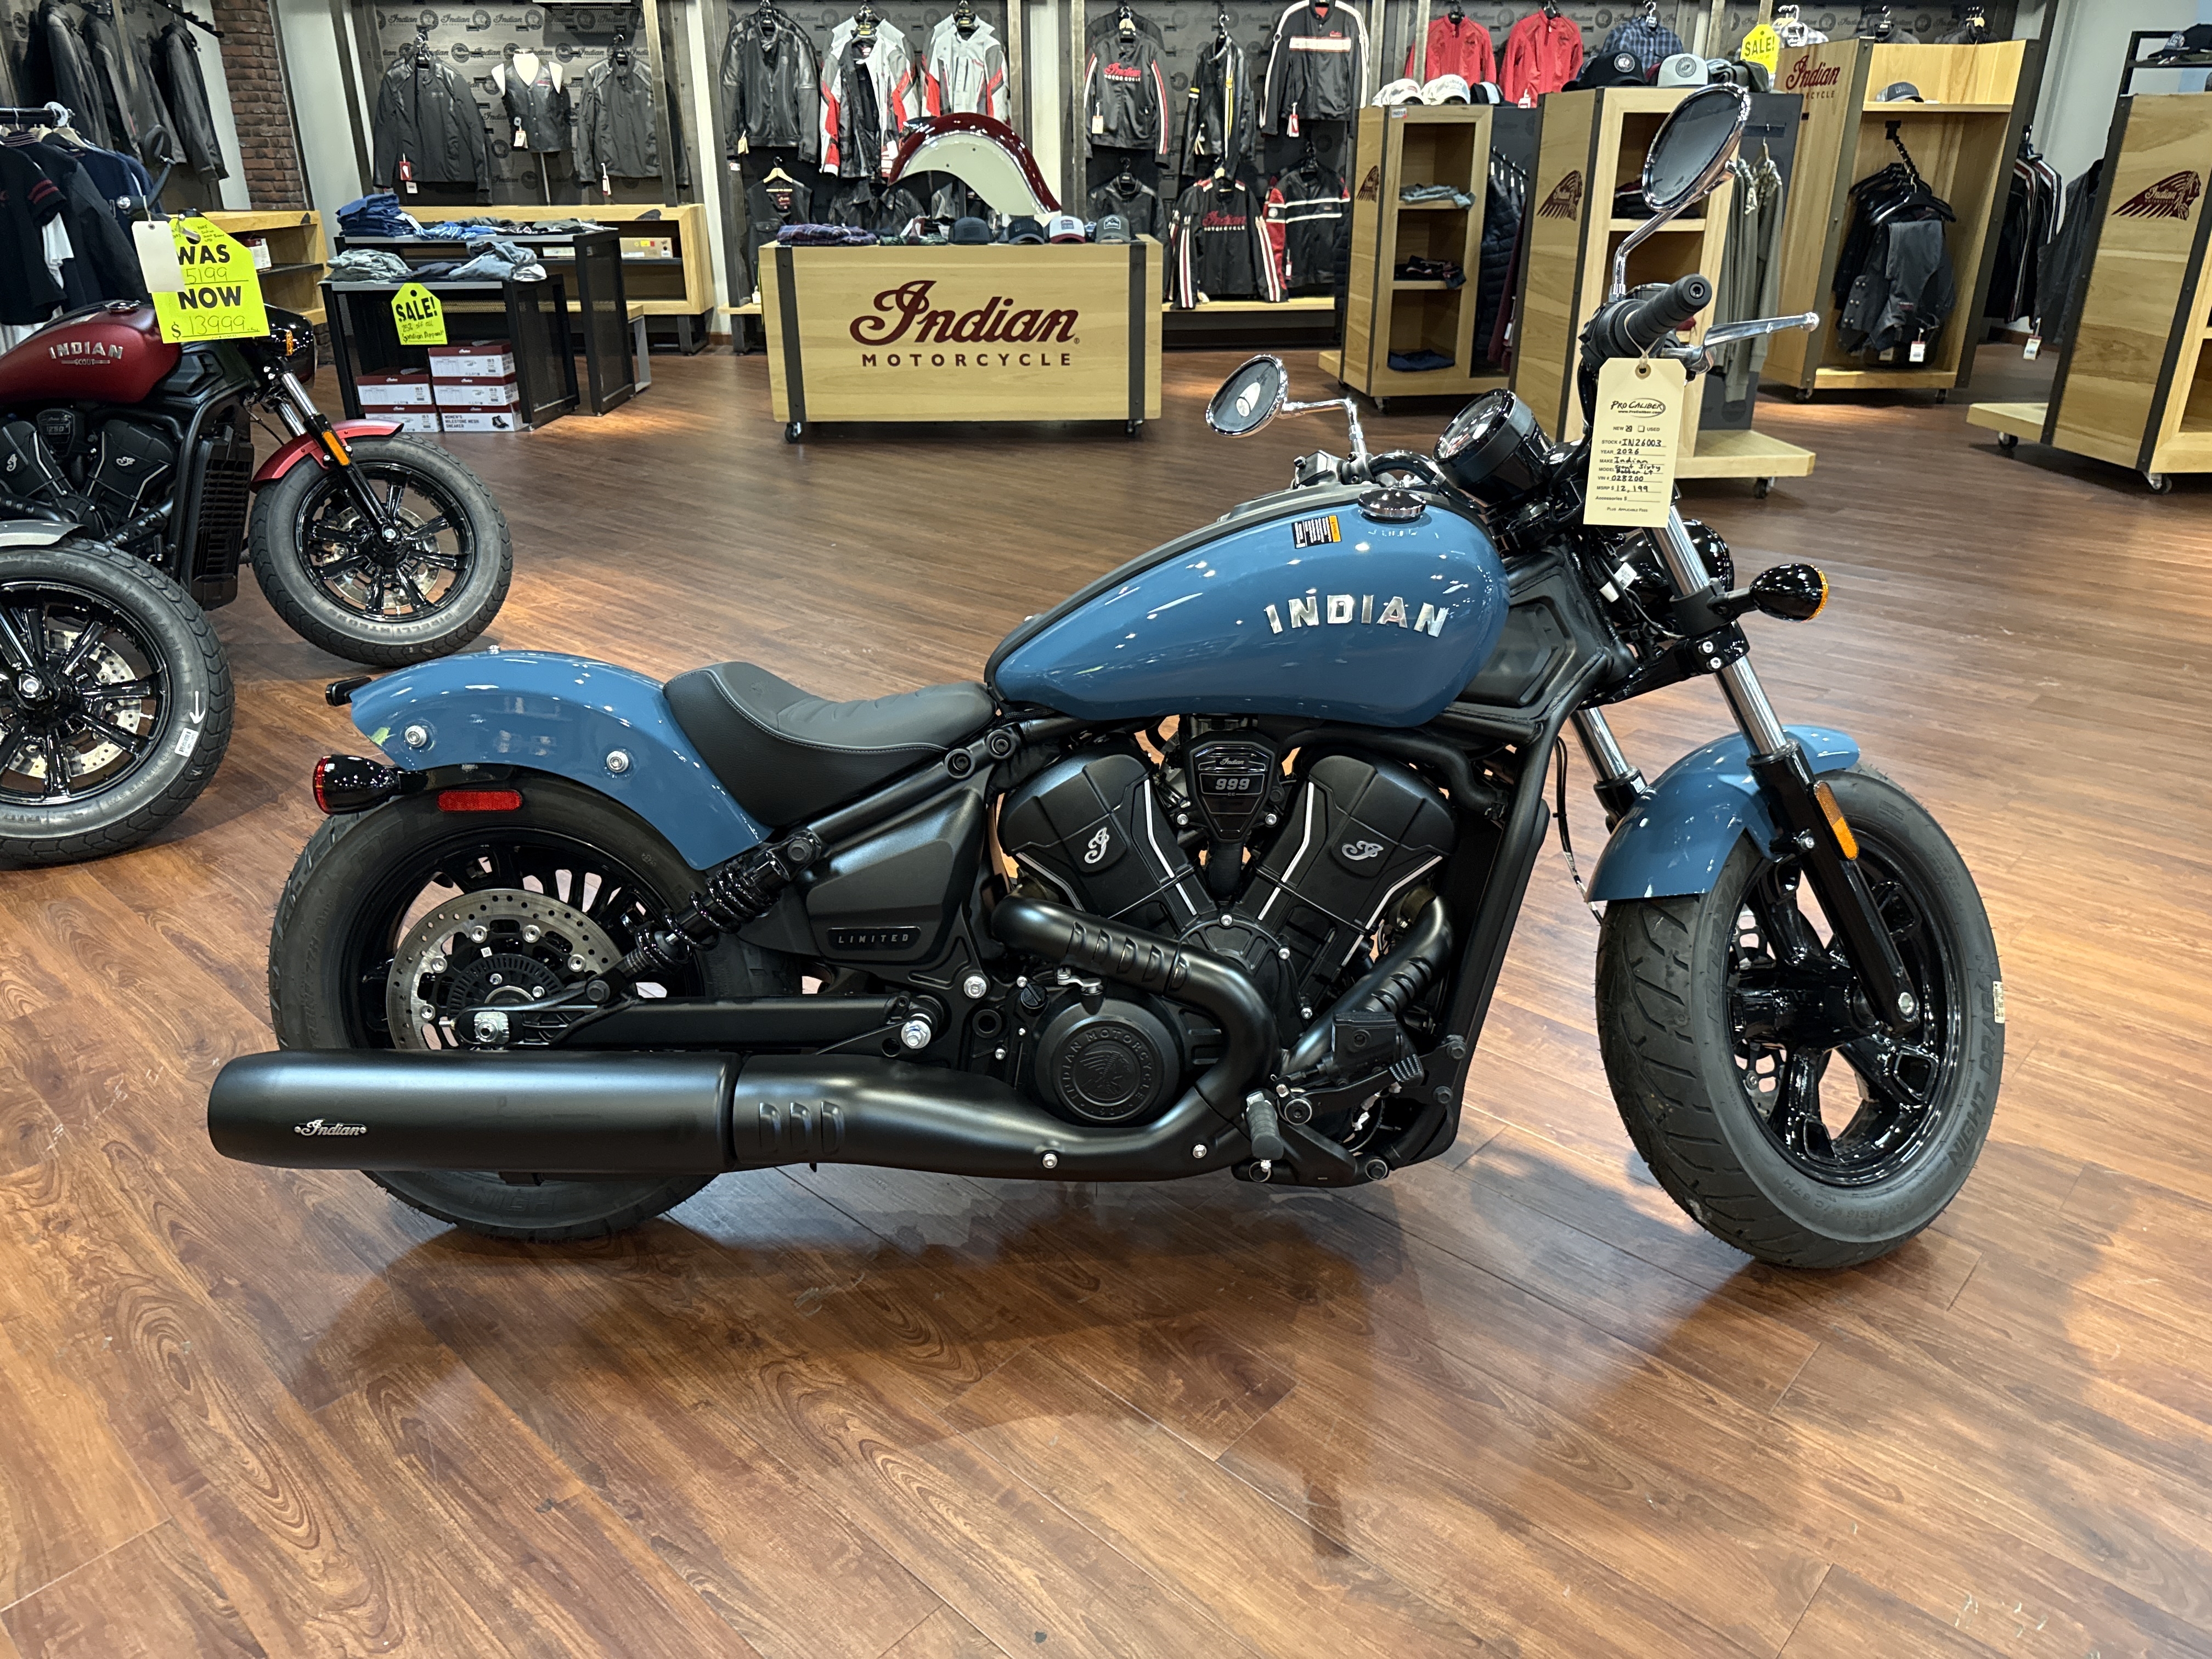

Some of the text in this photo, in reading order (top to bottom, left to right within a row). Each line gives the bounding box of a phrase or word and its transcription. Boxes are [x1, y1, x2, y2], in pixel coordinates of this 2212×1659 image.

[388, 14, 417, 23] Indian
[441, 14, 470, 23] Indian
[493, 14, 522, 23] Indian
[1744, 36, 1775, 57] SALE!
[1104, 62, 1141, 76] Indian
[1786, 55, 1841, 91] Indian
[2145, 185, 2177, 199] Indian
[177, 244, 230, 266] WAS
[177, 286, 241, 310] NOW
[396, 296, 438, 322] SALE!
[850, 280, 1079, 346] Indian
[171, 315, 246, 340] $ 13999
[48, 341, 123, 359] INDIAN
[862, 353, 1071, 368] MOTORCYCLE
[1610, 400, 1663, 410] PRO CALIBER
[1621, 438, 1662, 447] IN26003
[1264, 595, 1450, 637] INDIAN
[1215, 778, 1250, 790] 999
[838, 934, 909, 944] LIMITED
[1085, 1029, 1152, 1100] MOTORCYCLE
[301, 1119, 359, 1136] Indian
[1948, 1081, 1987, 1166] NIGHT
